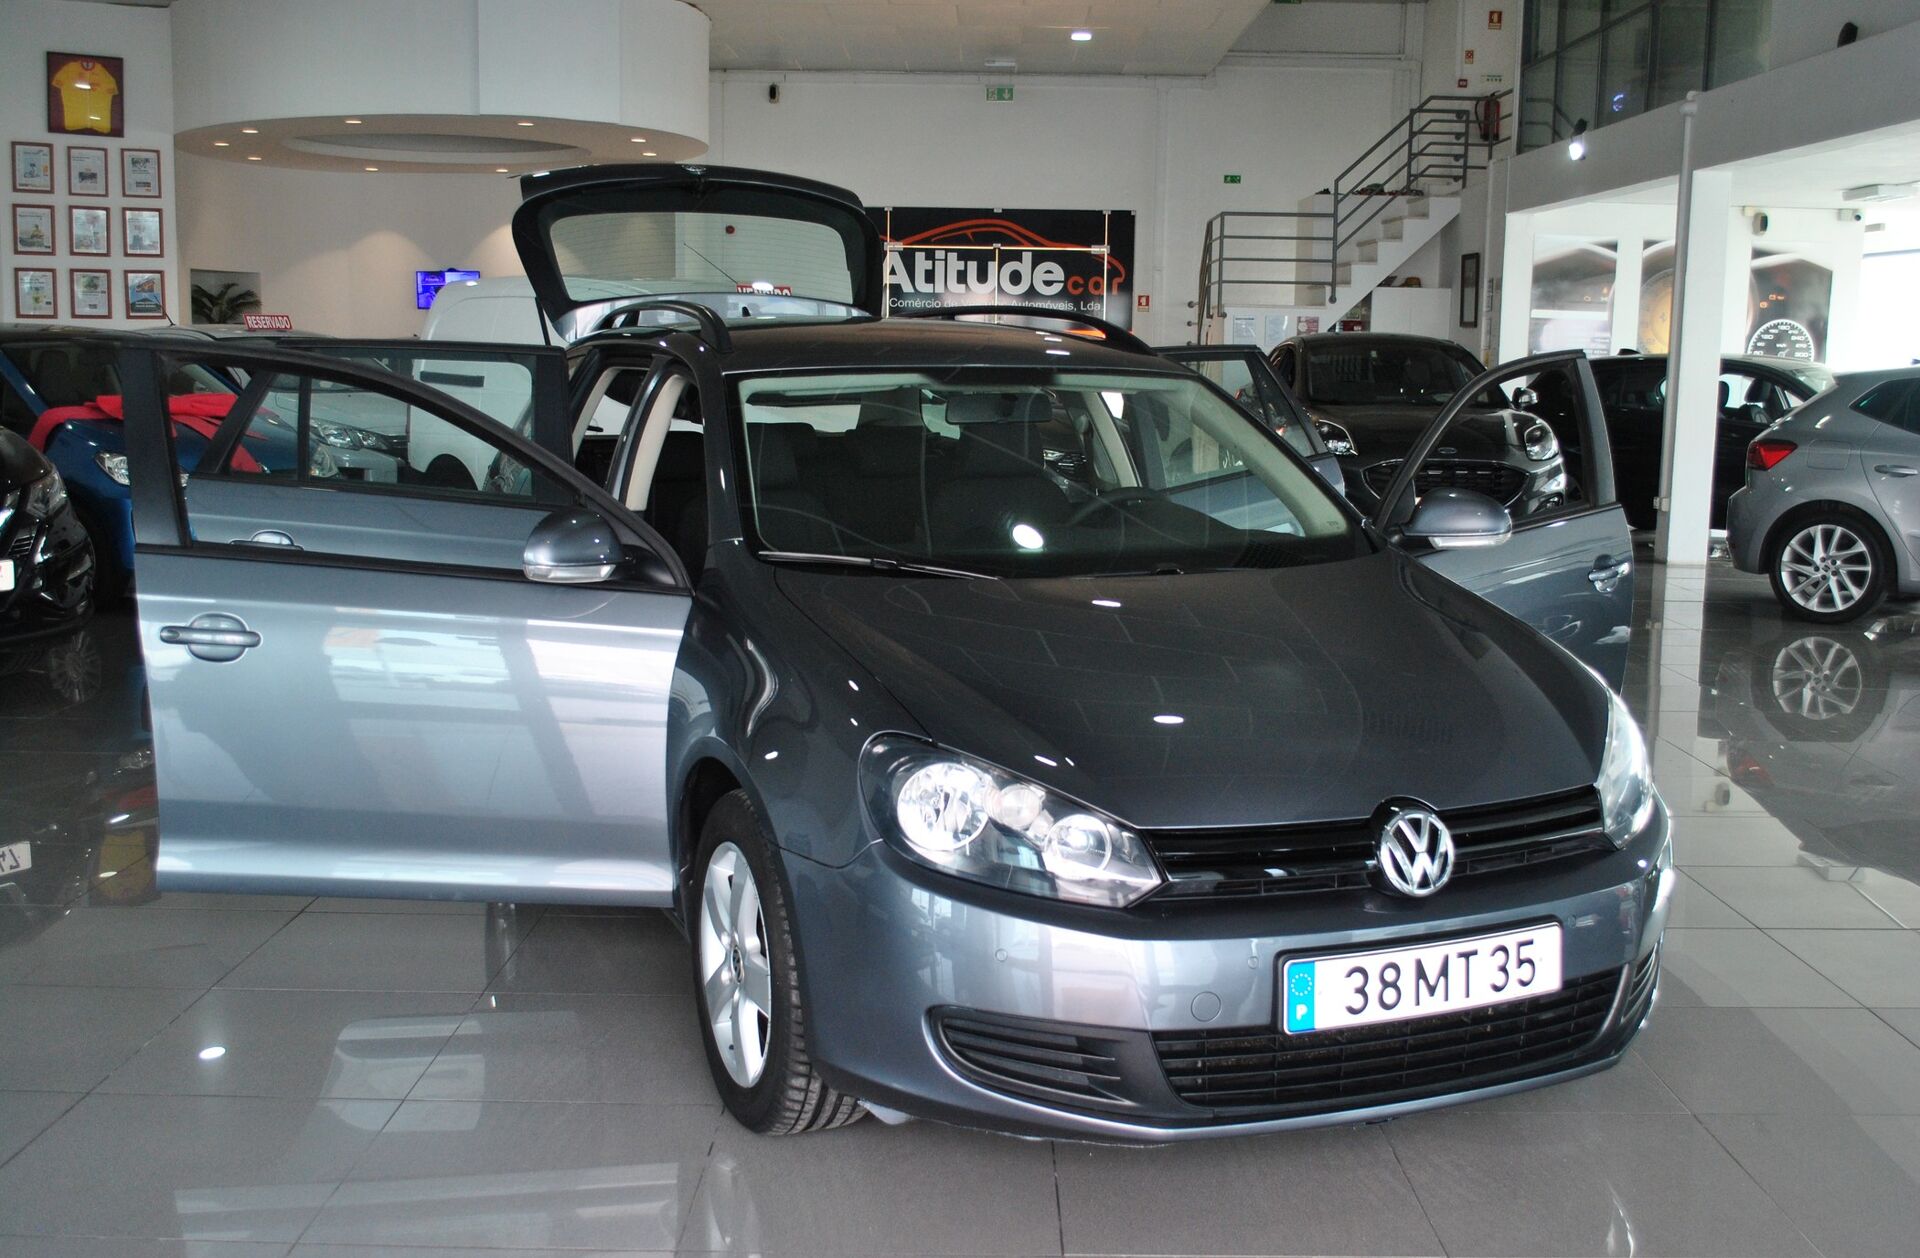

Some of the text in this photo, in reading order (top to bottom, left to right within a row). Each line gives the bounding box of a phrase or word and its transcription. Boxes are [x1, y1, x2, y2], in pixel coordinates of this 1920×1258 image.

[883, 250, 1065, 296] Atitude
[889, 297, 942, 309] Comércio
[246, 315, 291, 329] RESERVADO
[1344, 938, 1537, 1015] 38 MT 35
[1295, 1003, 1309, 1021] P
